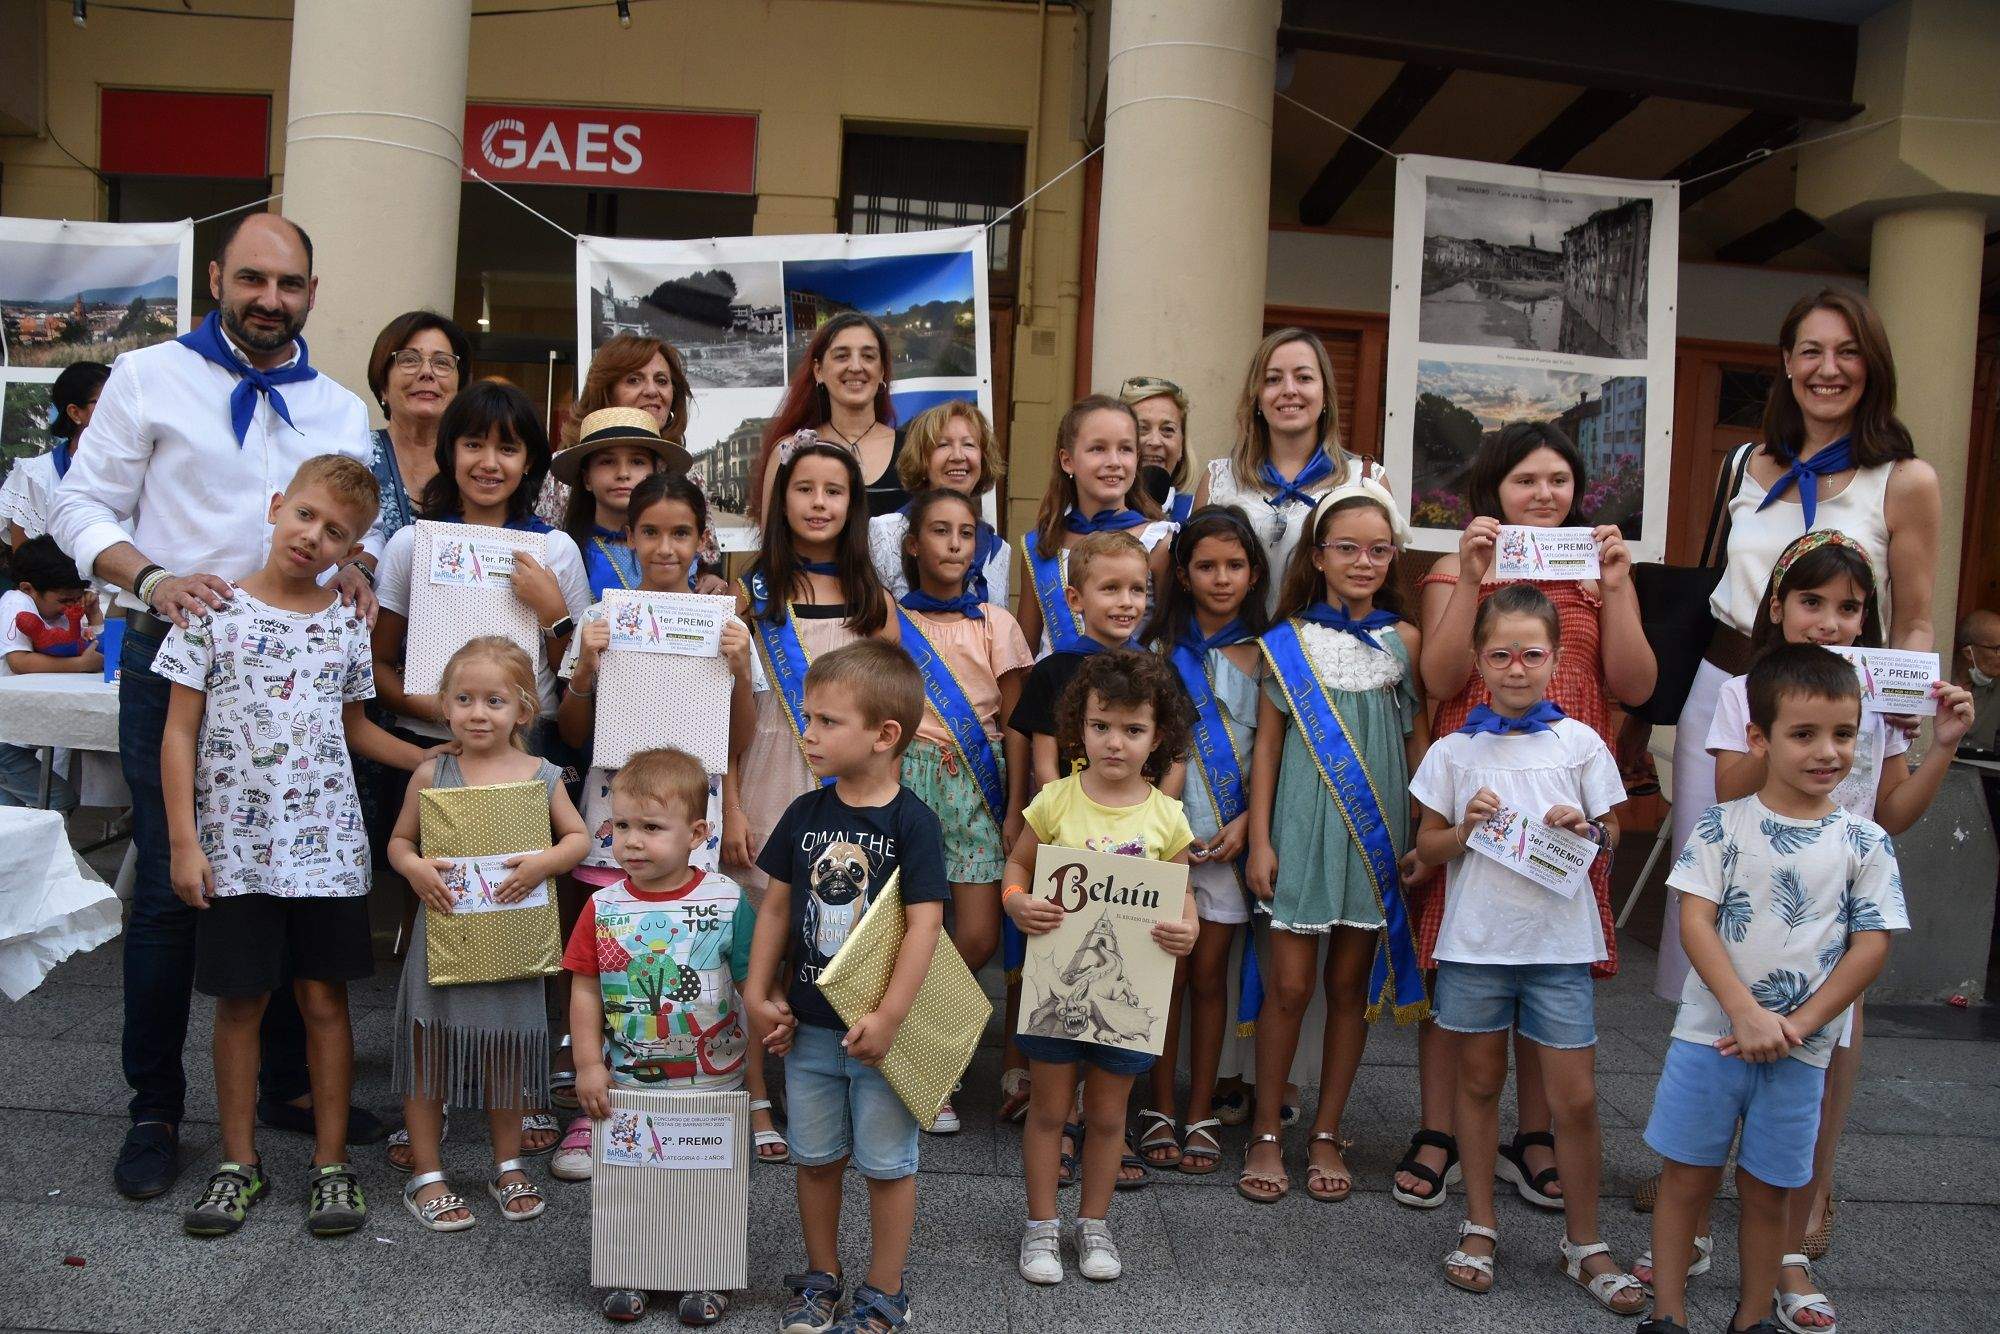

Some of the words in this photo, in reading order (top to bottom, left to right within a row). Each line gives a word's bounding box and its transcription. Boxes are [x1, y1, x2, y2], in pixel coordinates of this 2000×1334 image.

[481, 118, 643, 175] GAES
[480, 554, 496, 562] 1er.
[498, 556, 516, 565] PRE
[254, 619, 294, 634] cooking
[677, 617, 714, 627] PREMIO
[768, 626, 792, 679] ama
[914, 647, 951, 709] Dama
[1872, 668, 1886, 676] 2º.
[1888, 669, 1929, 679] PREMIO
[1195, 687, 1214, 756] Dma
[1292, 674, 1326, 744] Dama
[1325, 752, 1374, 837] Infantil
[242, 788, 272, 805] cooking
[802, 831, 849, 851] OWN
[856, 832, 896, 857] THE
[1528, 833, 1545, 847] 3er.
[1546, 842, 1584, 867] PREMIO
[1044, 863, 1159, 913] Belaín
[682, 904, 718, 917] TUC
[823, 909, 848, 925] AWE
[682, 918, 719, 932] TUC
[661, 1137, 674, 1145] 2º.
[678, 1137, 722, 1145] PREMIO
